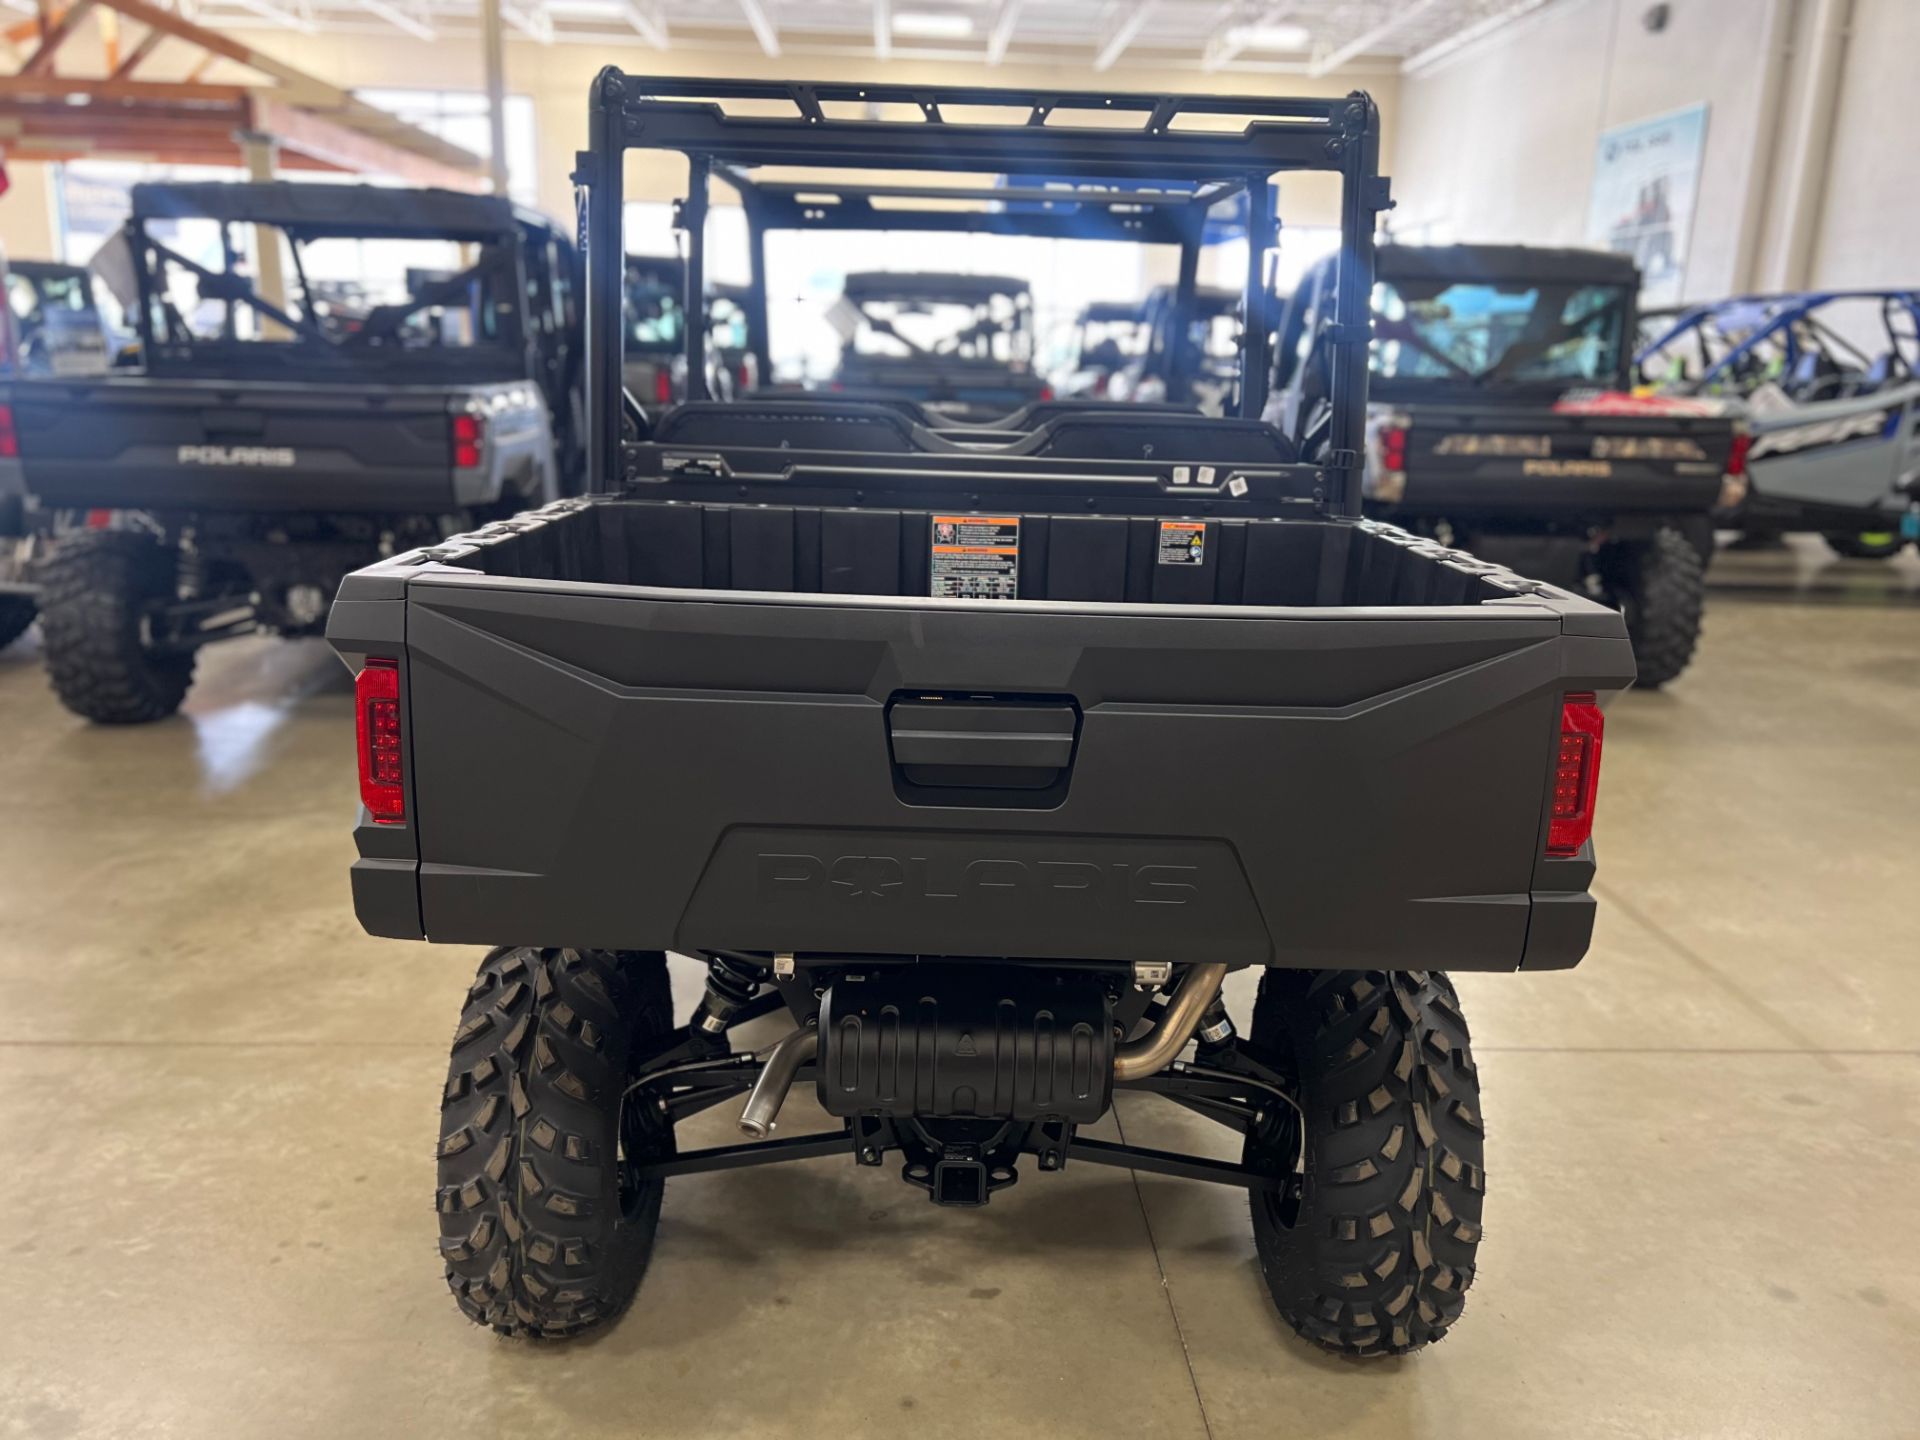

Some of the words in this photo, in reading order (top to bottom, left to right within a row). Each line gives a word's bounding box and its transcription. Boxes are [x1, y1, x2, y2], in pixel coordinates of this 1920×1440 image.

[178, 445, 295, 467] POLARIS
[1523, 460, 1611, 477] POLARIS
[758, 853, 1201, 910] POLARIS
